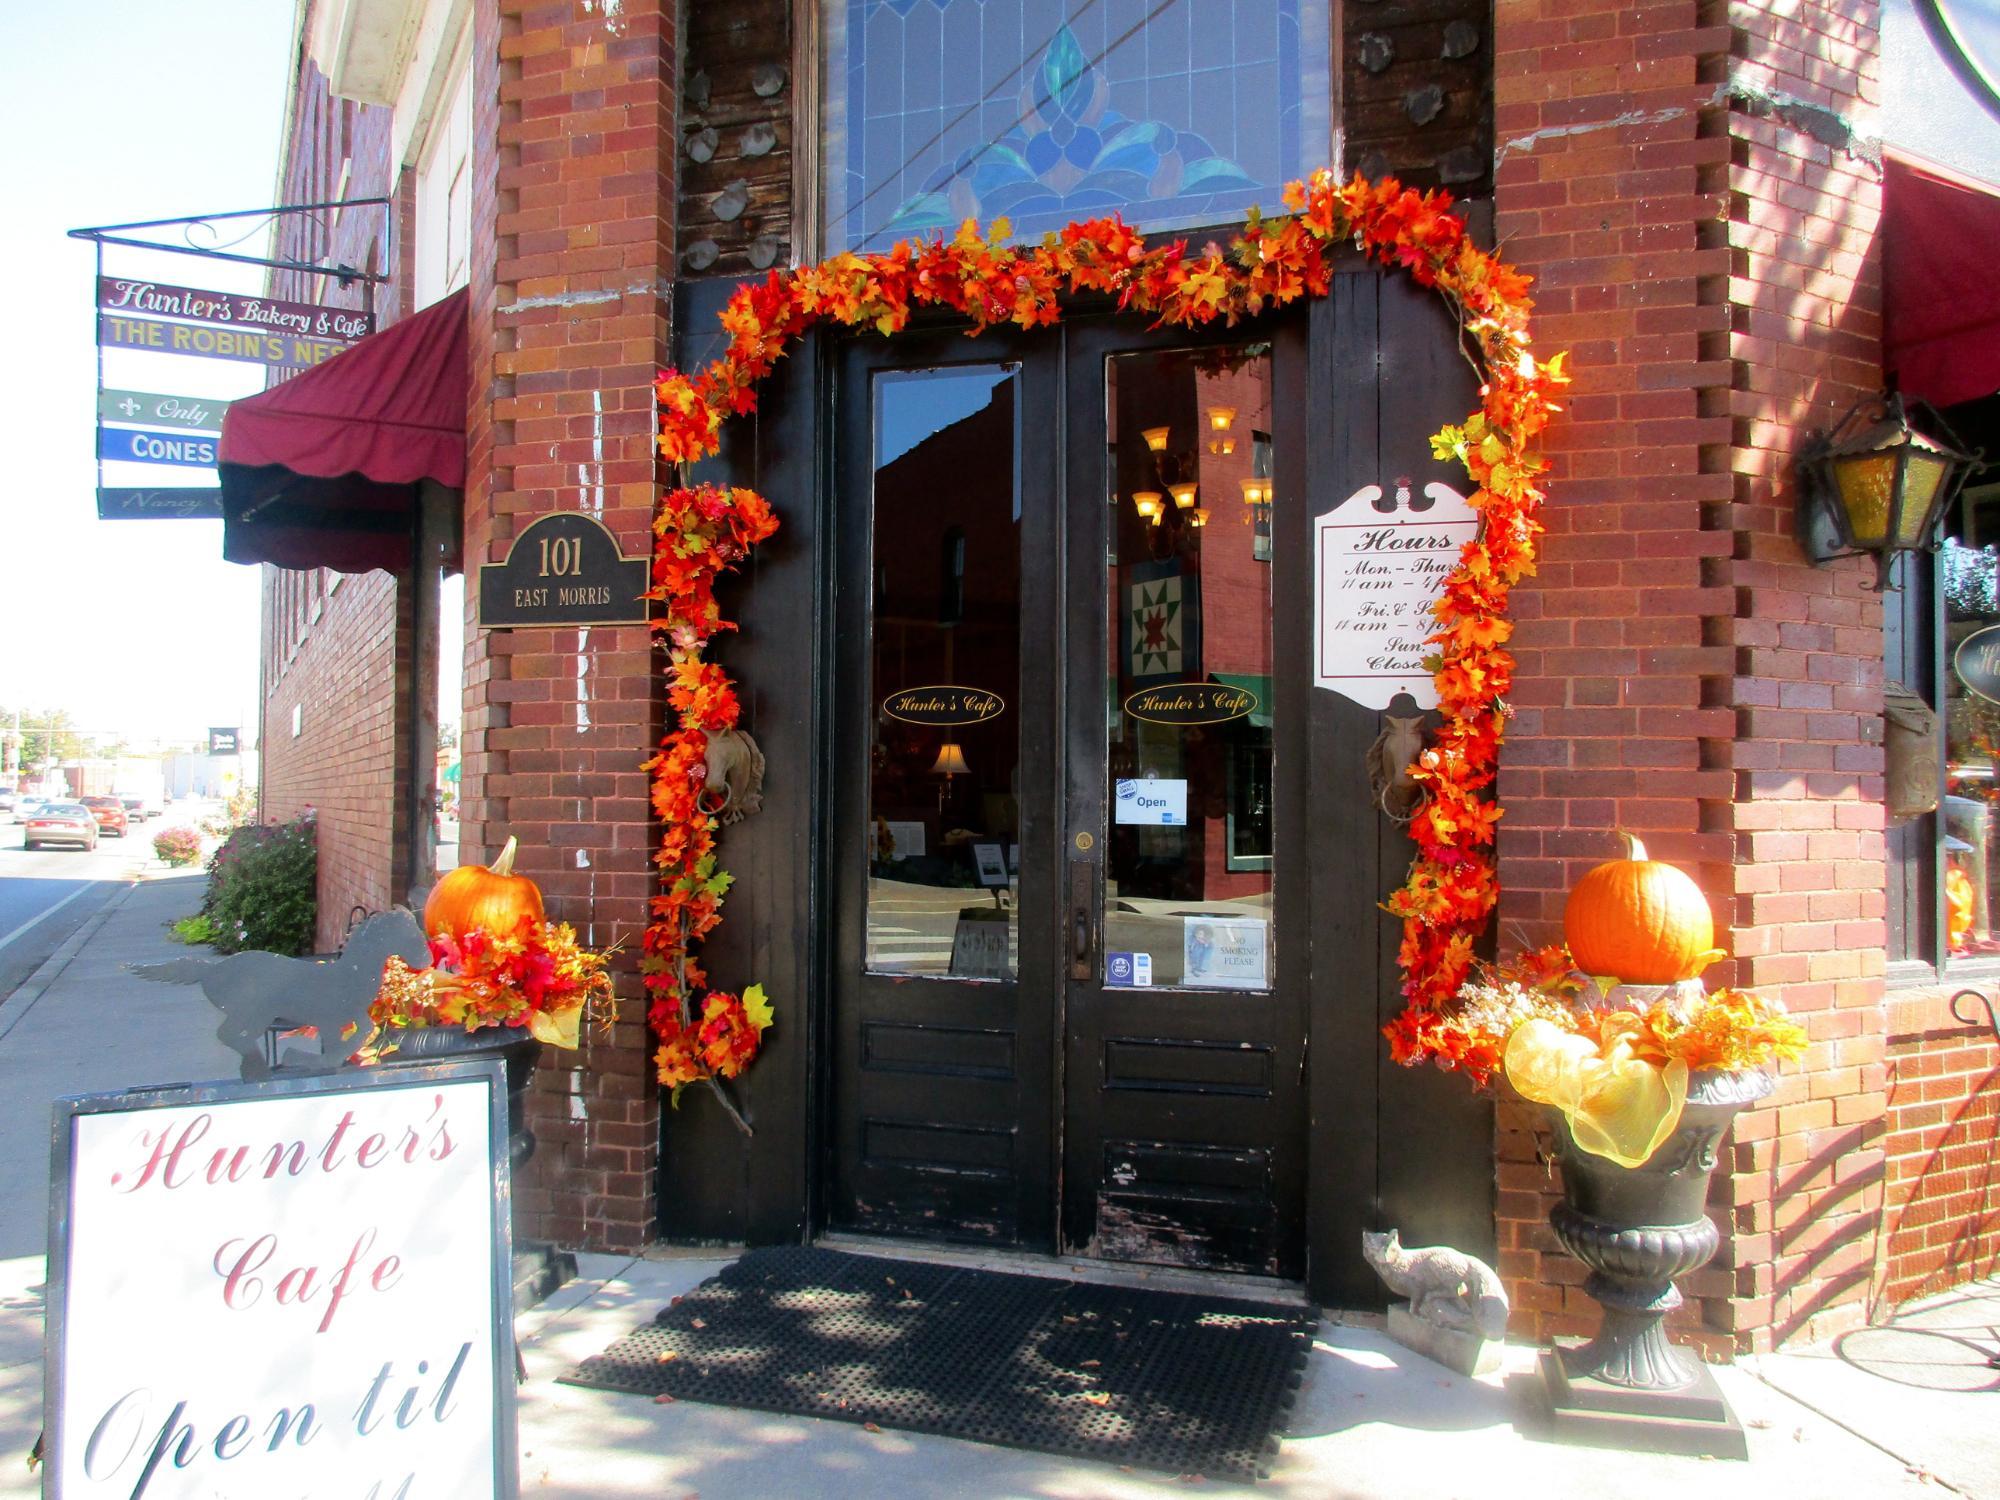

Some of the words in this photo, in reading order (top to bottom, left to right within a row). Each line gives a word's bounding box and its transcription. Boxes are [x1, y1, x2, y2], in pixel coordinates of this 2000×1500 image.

[108, 281, 232, 320] Hunter's
[238, 301, 311, 332] Bakery
[316, 312, 331, 334] &
[110, 318, 165, 347] THE
[173, 326, 285, 361] ROBIN'S
[294, 341, 346, 365] NE
[156, 399, 209, 425] Only
[132, 434, 214, 463] CONES
[122, 492, 203, 516] Nancy
[1353, 529, 1453, 551] Hours
[538, 537, 582, 577] 101
[1344, 559, 1392, 575] Mon.
[1411, 557, 1459, 573] Thur
[515, 588, 549, 608] EAST
[559, 587, 611, 606] MORRIS
[1384, 636, 1426, 652] Sun.
[1366, 656, 1422, 670] Close
[895, 696, 957, 711] Hunter's
[1138, 693, 1205, 711] Hunter's
[1137, 796, 1167, 809] Open
[1219, 947, 1259, 956] SMOKING
[1224, 957, 1255, 966] PLEASE
[110, 1093, 460, 1194] Hunter's
[213, 1227, 404, 1333] Cafe
[84, 1386, 323, 1500] Open
[351, 1342, 474, 1437] til
